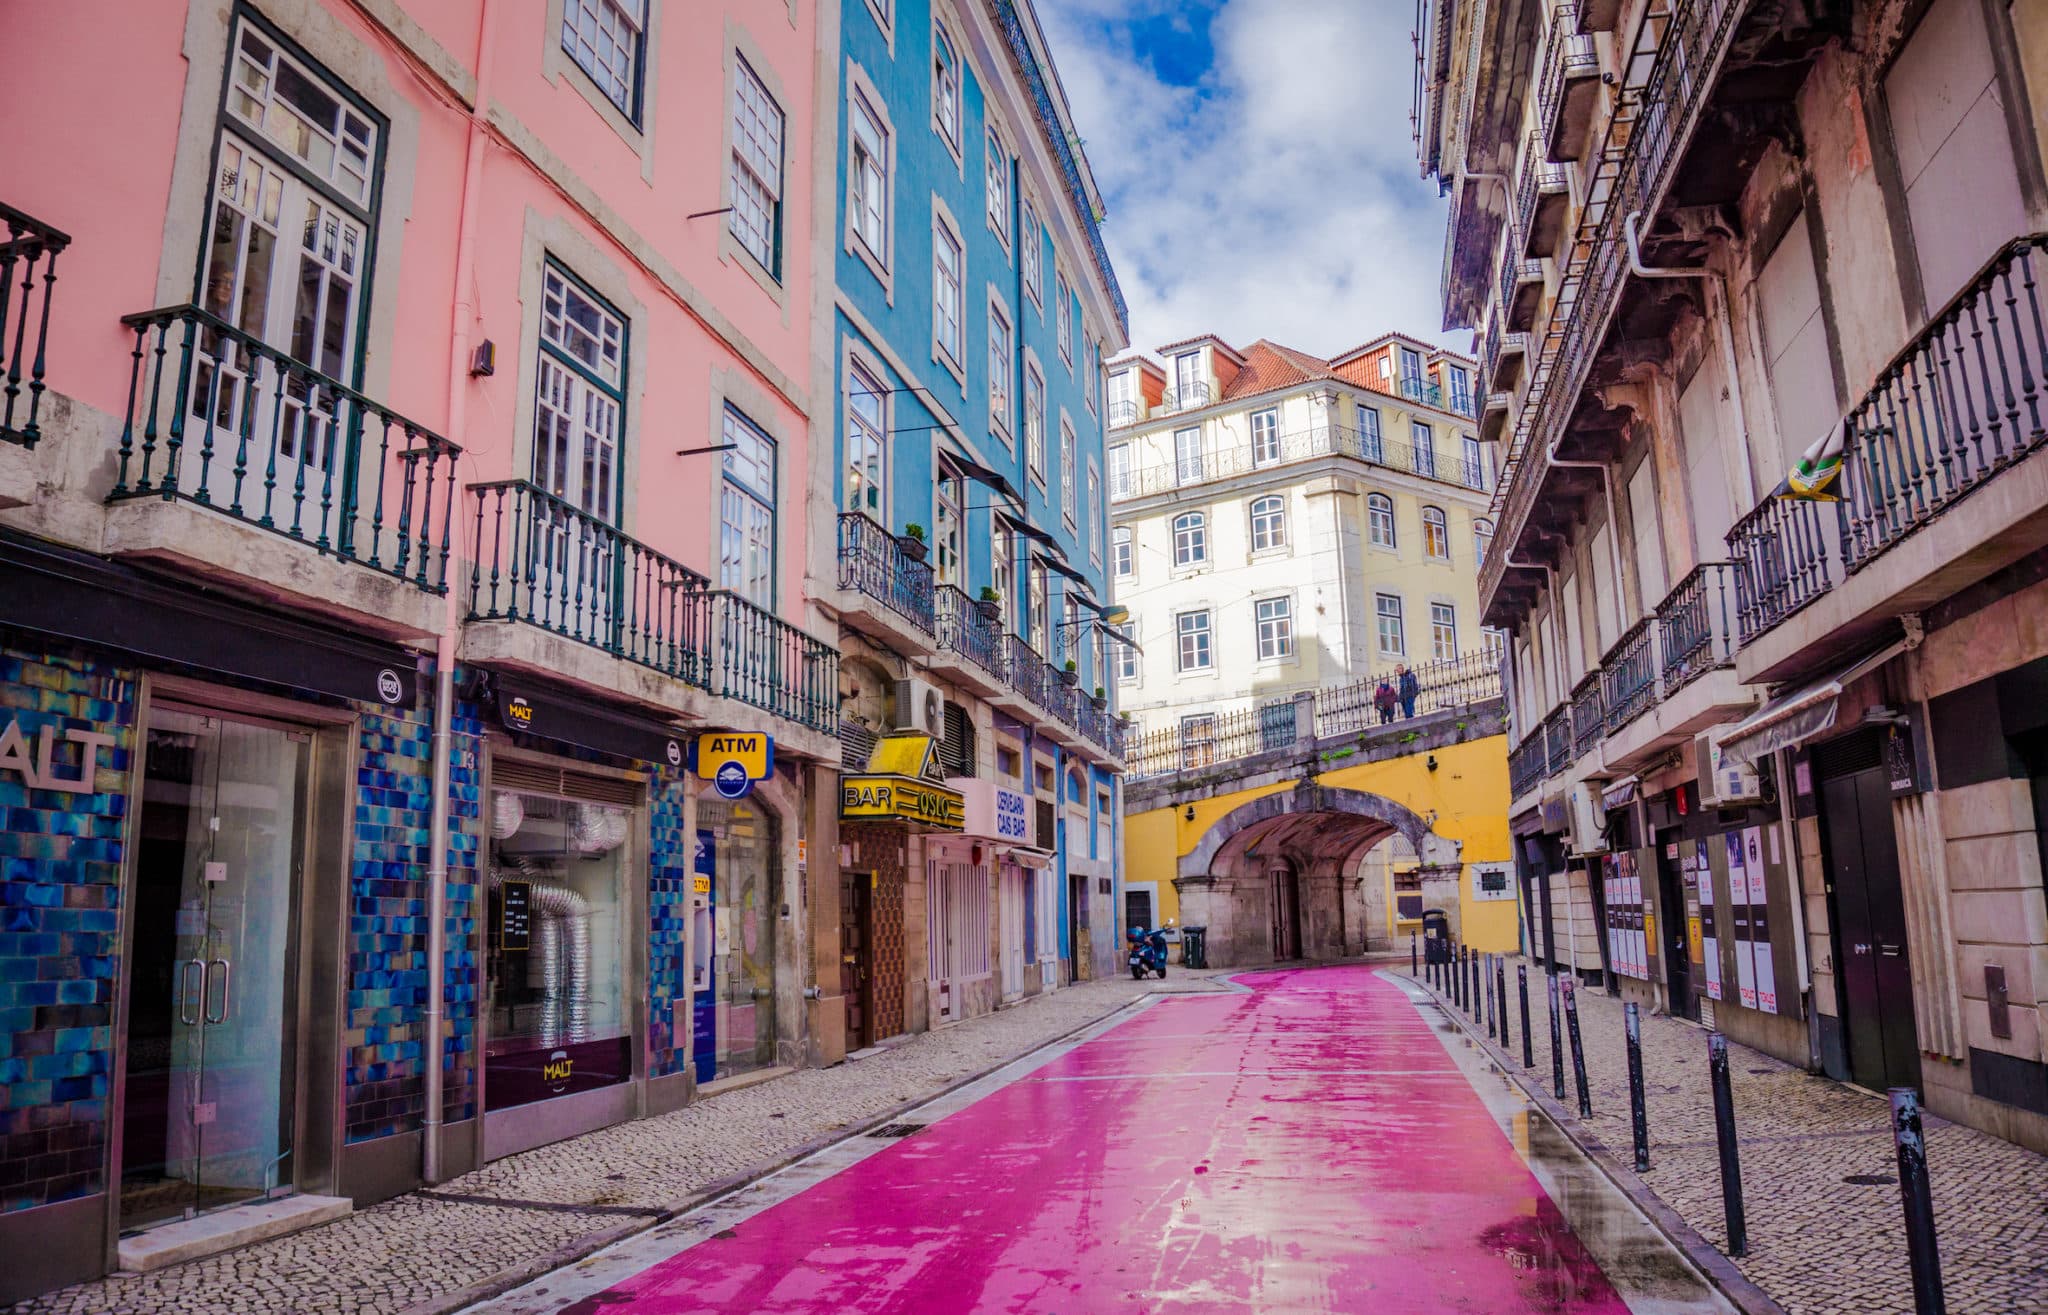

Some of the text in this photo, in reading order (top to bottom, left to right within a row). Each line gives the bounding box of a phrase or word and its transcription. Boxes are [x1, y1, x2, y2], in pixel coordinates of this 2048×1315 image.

[509, 703, 533, 721] MALT
[710, 738, 756, 753] ATM
[844, 787, 951, 818] BAR OSLO
[1013, 817, 1026, 838] BAR
[544, 1059, 574, 1081] MALT
